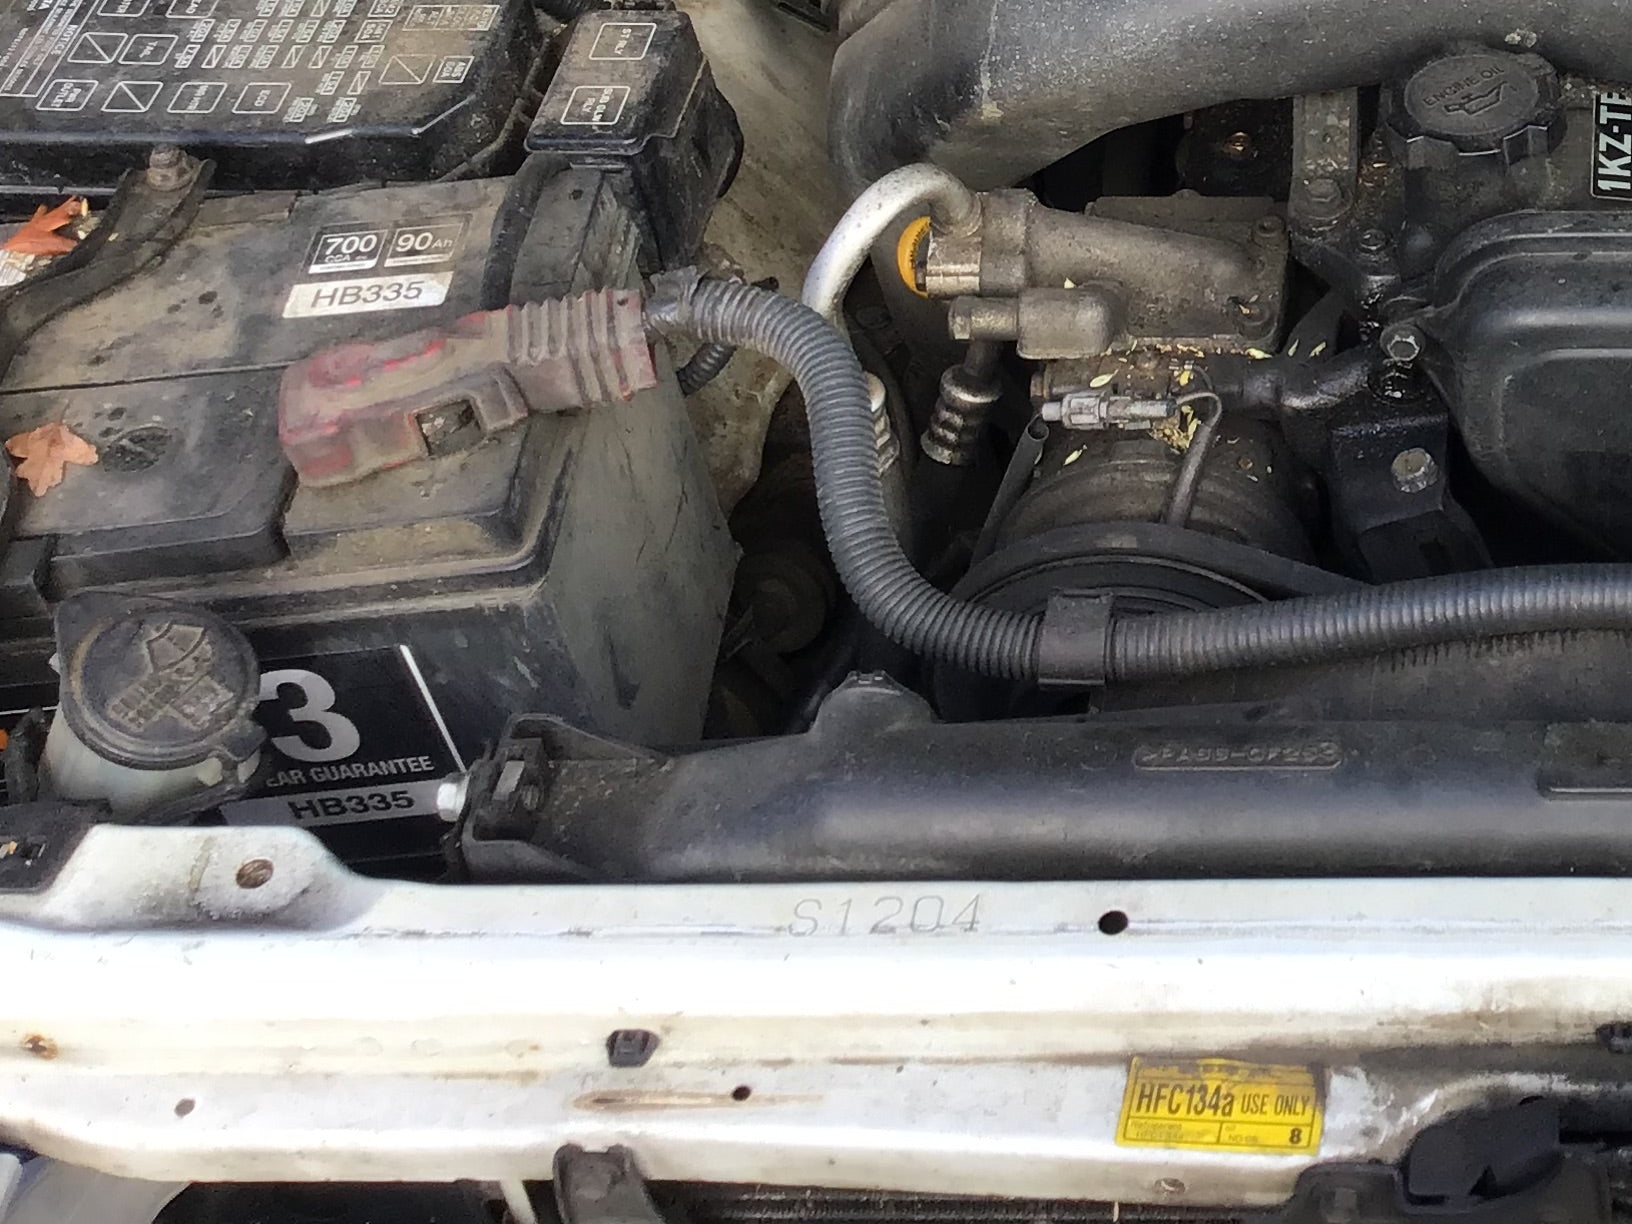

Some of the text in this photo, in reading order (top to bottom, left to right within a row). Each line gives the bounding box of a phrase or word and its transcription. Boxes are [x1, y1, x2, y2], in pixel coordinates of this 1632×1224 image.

[51, 25, 78, 55] NOTICE
[614, 28, 632, 55] ST RLY
[51, 83, 74, 108] OUTLET
[599, 88, 614, 104] SUB
[1424, 64, 1506, 106] ENGINE OIL
[582, 97, 596, 113] RLY
[324, 234, 378, 256] 700
[324, 254, 352, 264] CCA
[310, 280, 426, 309] HB335
[259, 668, 361, 763] 3
[309, 755, 436, 785] GUARANTEE
[288, 790, 416, 823] HB335
[788, 893, 981, 937] S1204
[1136, 1083, 1311, 1118] HFC134a USE ONLY
[1288, 1127, 1303, 1145] 8
